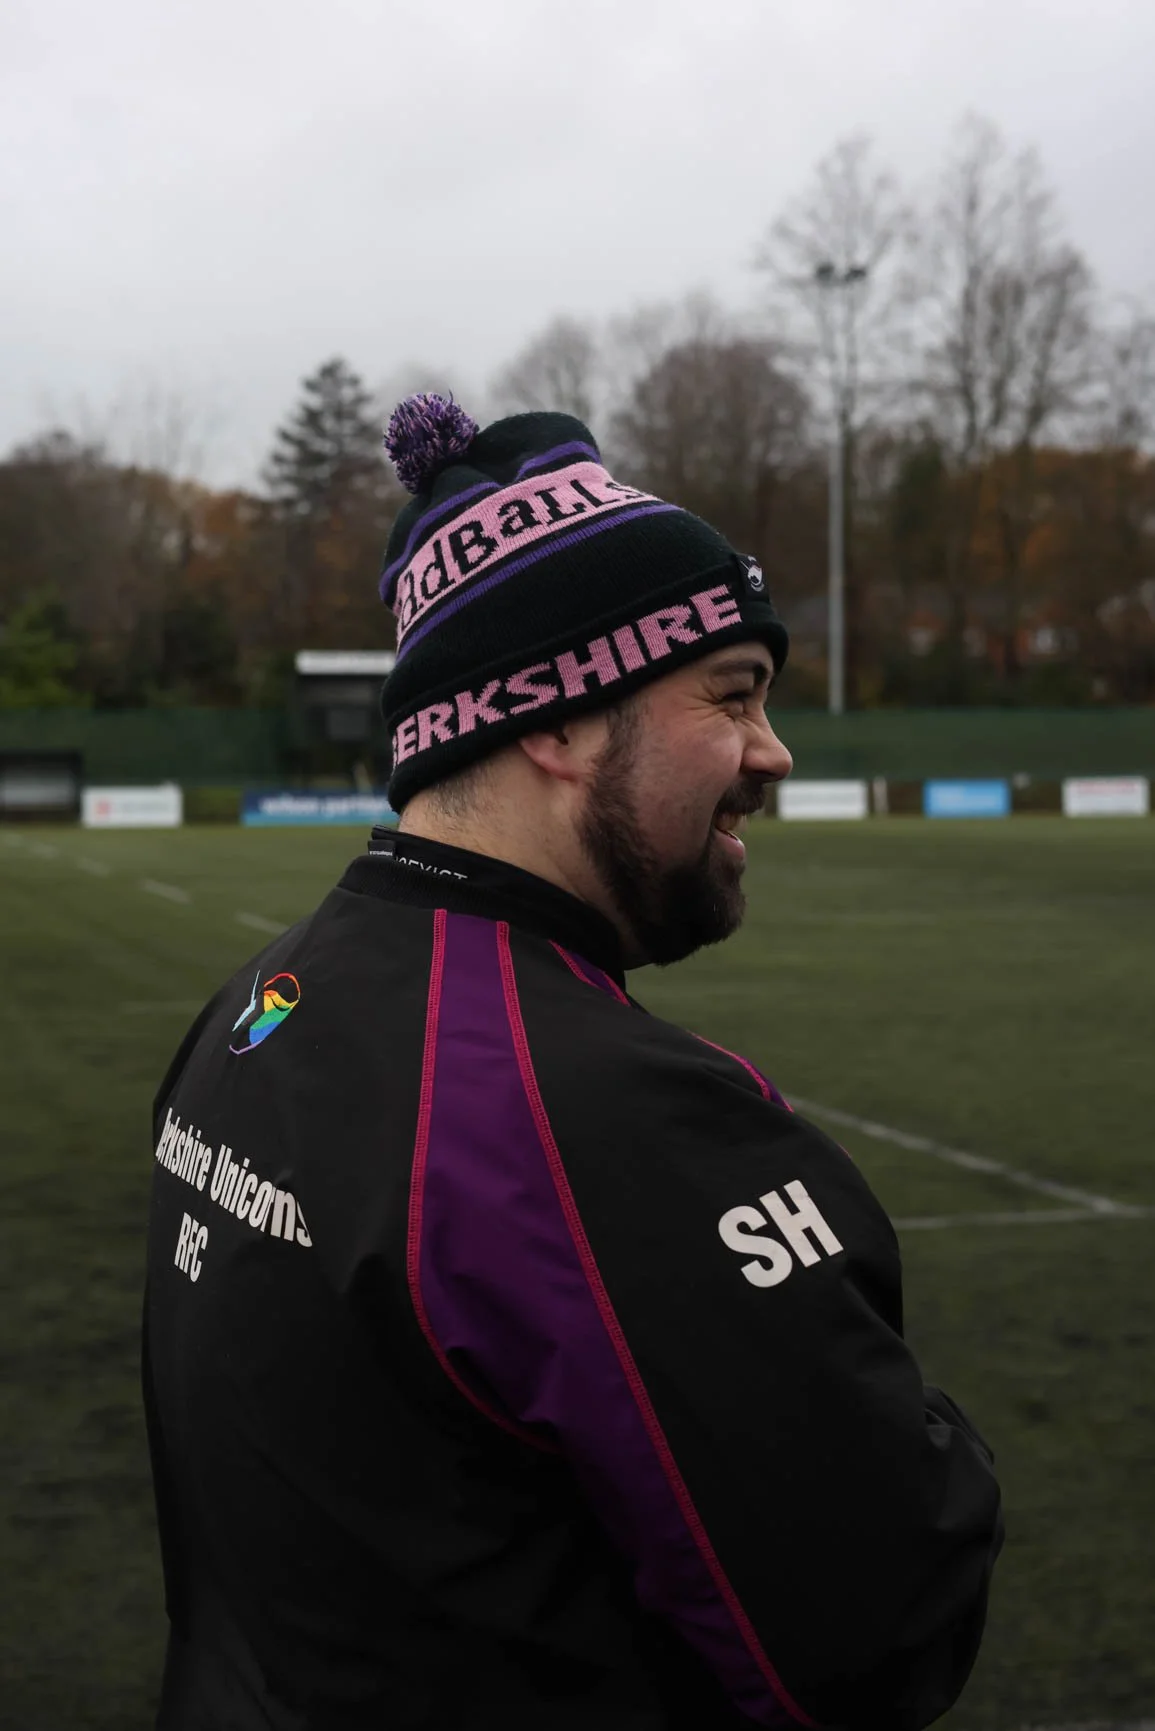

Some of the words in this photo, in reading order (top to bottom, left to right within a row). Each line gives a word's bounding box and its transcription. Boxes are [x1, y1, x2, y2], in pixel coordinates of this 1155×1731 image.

[391, 583, 742, 777] ERKSHIRE
[174, 1211, 208, 1283] RFC
[718, 1179, 844, 1288] SH
